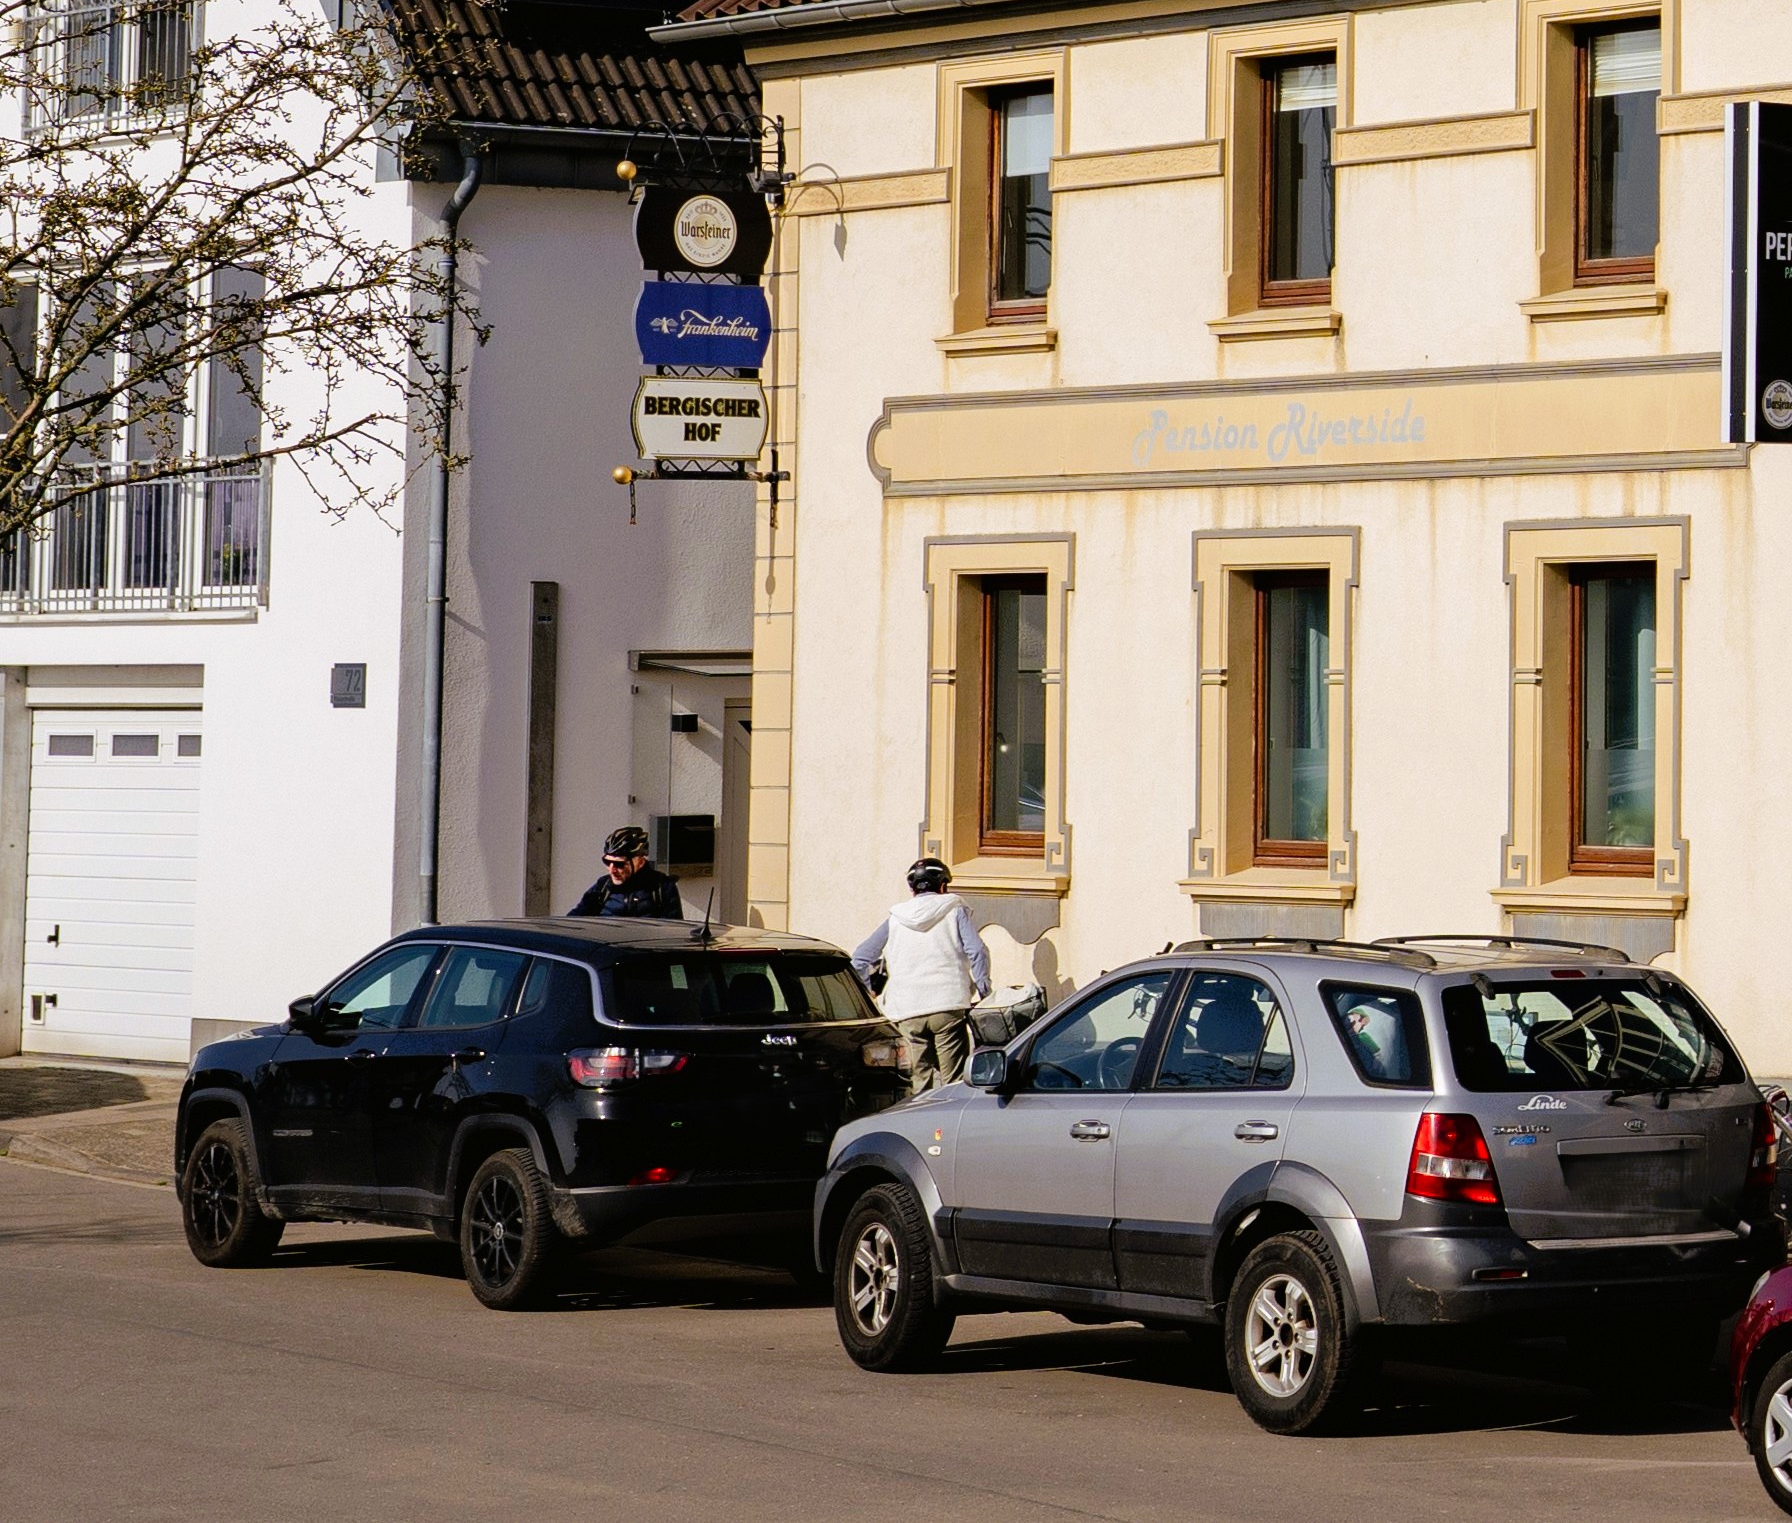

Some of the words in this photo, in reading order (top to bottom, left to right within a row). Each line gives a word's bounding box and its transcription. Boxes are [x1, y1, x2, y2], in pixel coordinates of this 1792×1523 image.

[680, 220, 731, 240] Warsteiner
[677, 309, 759, 341] Frankenheim
[643, 395, 761, 419] BERGISCHER
[683, 422, 723, 443] HOF
[1131, 407, 1259, 468] Pension
[1266, 396, 1427, 464] Riverside
[345, 669, 361, 692] 72
[761, 1034, 797, 1046] Jeep
[1517, 1094, 1568, 1111] Linde
